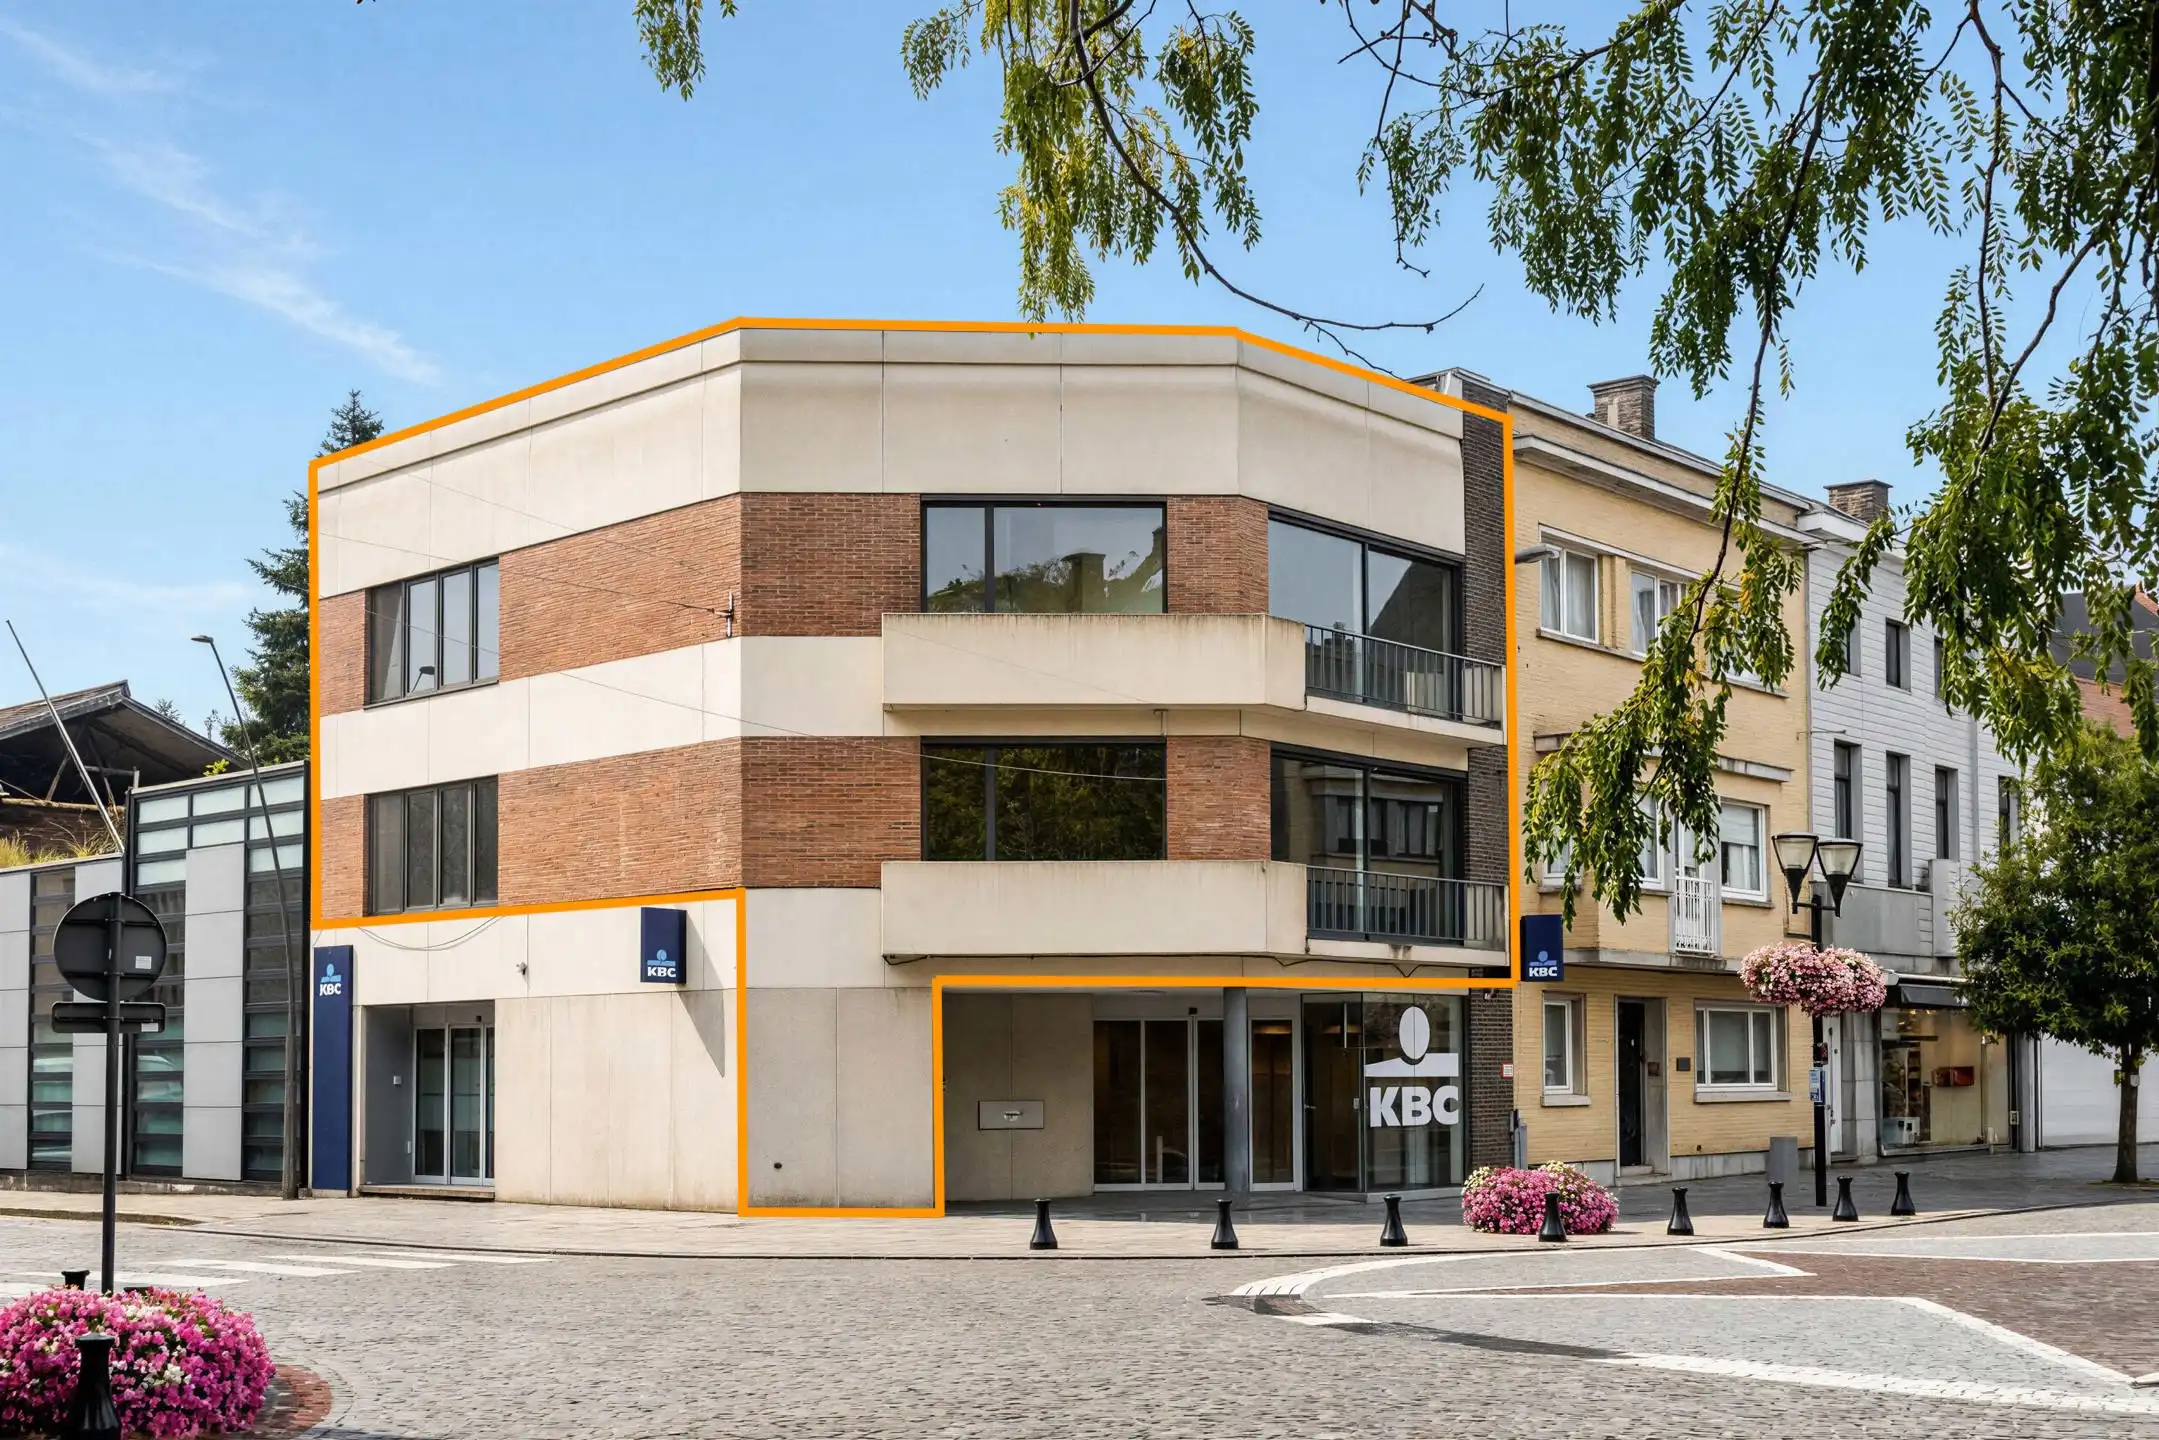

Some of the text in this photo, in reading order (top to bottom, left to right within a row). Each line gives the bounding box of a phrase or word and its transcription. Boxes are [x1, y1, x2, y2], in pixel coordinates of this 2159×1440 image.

[647, 966, 676, 978] KBC
[1528, 966, 1558, 977] KBC
[319, 983, 342, 996] KBC
[1369, 1085, 1459, 1128] KBC
